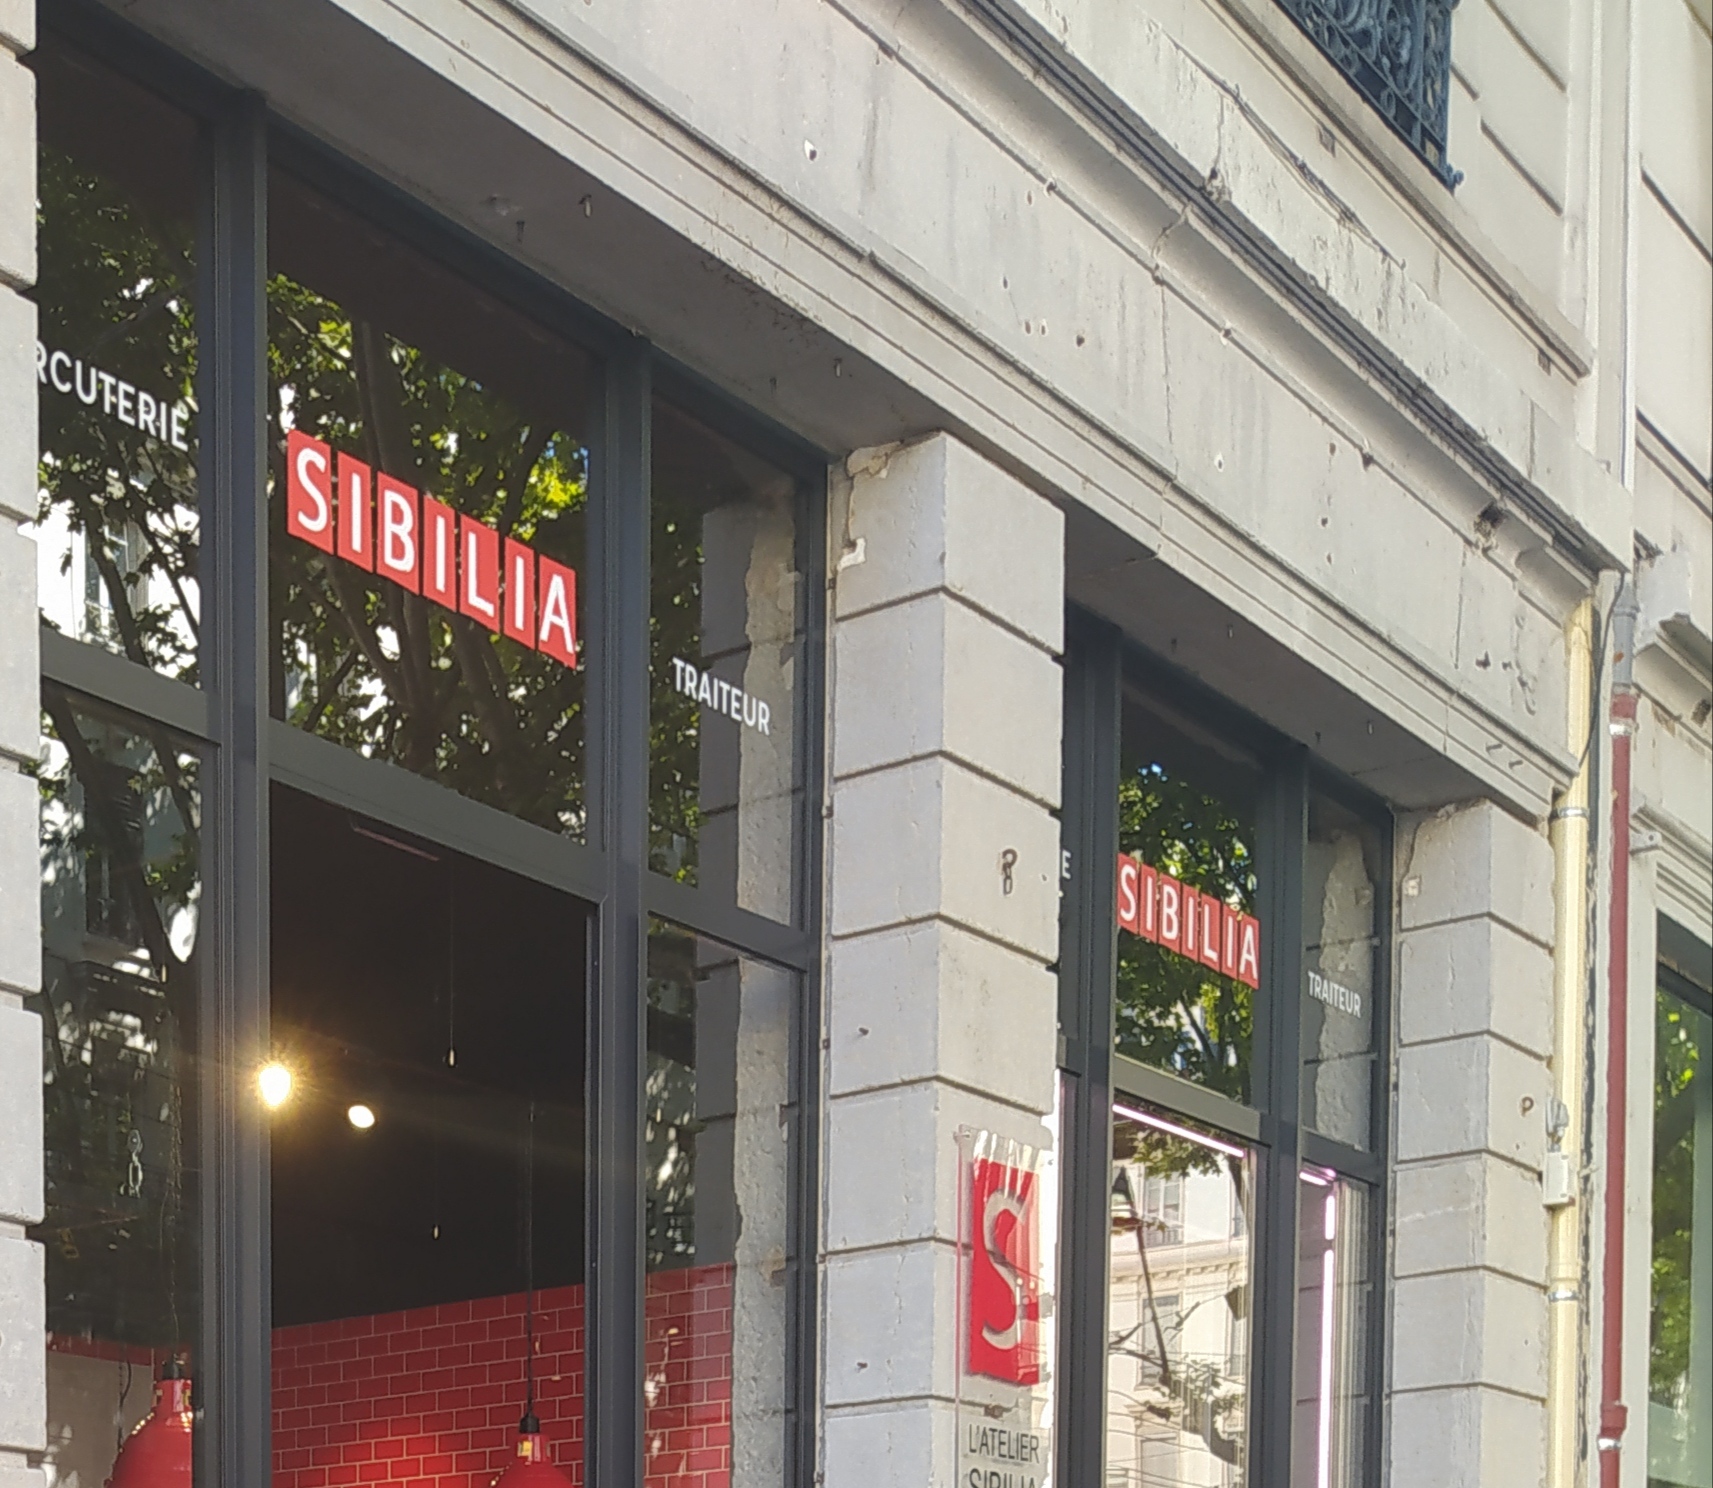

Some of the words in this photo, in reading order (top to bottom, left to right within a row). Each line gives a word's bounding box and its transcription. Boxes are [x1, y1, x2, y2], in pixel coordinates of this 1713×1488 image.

[296, 446, 575, 655] SIBILIA
[672, 656, 770, 736] TRAITEUR
[1119, 863, 1259, 981] SIBILIA
[1307, 969, 1362, 1019] TRAITEUR
[968, 1421, 1040, 1465] L'ATELIER
